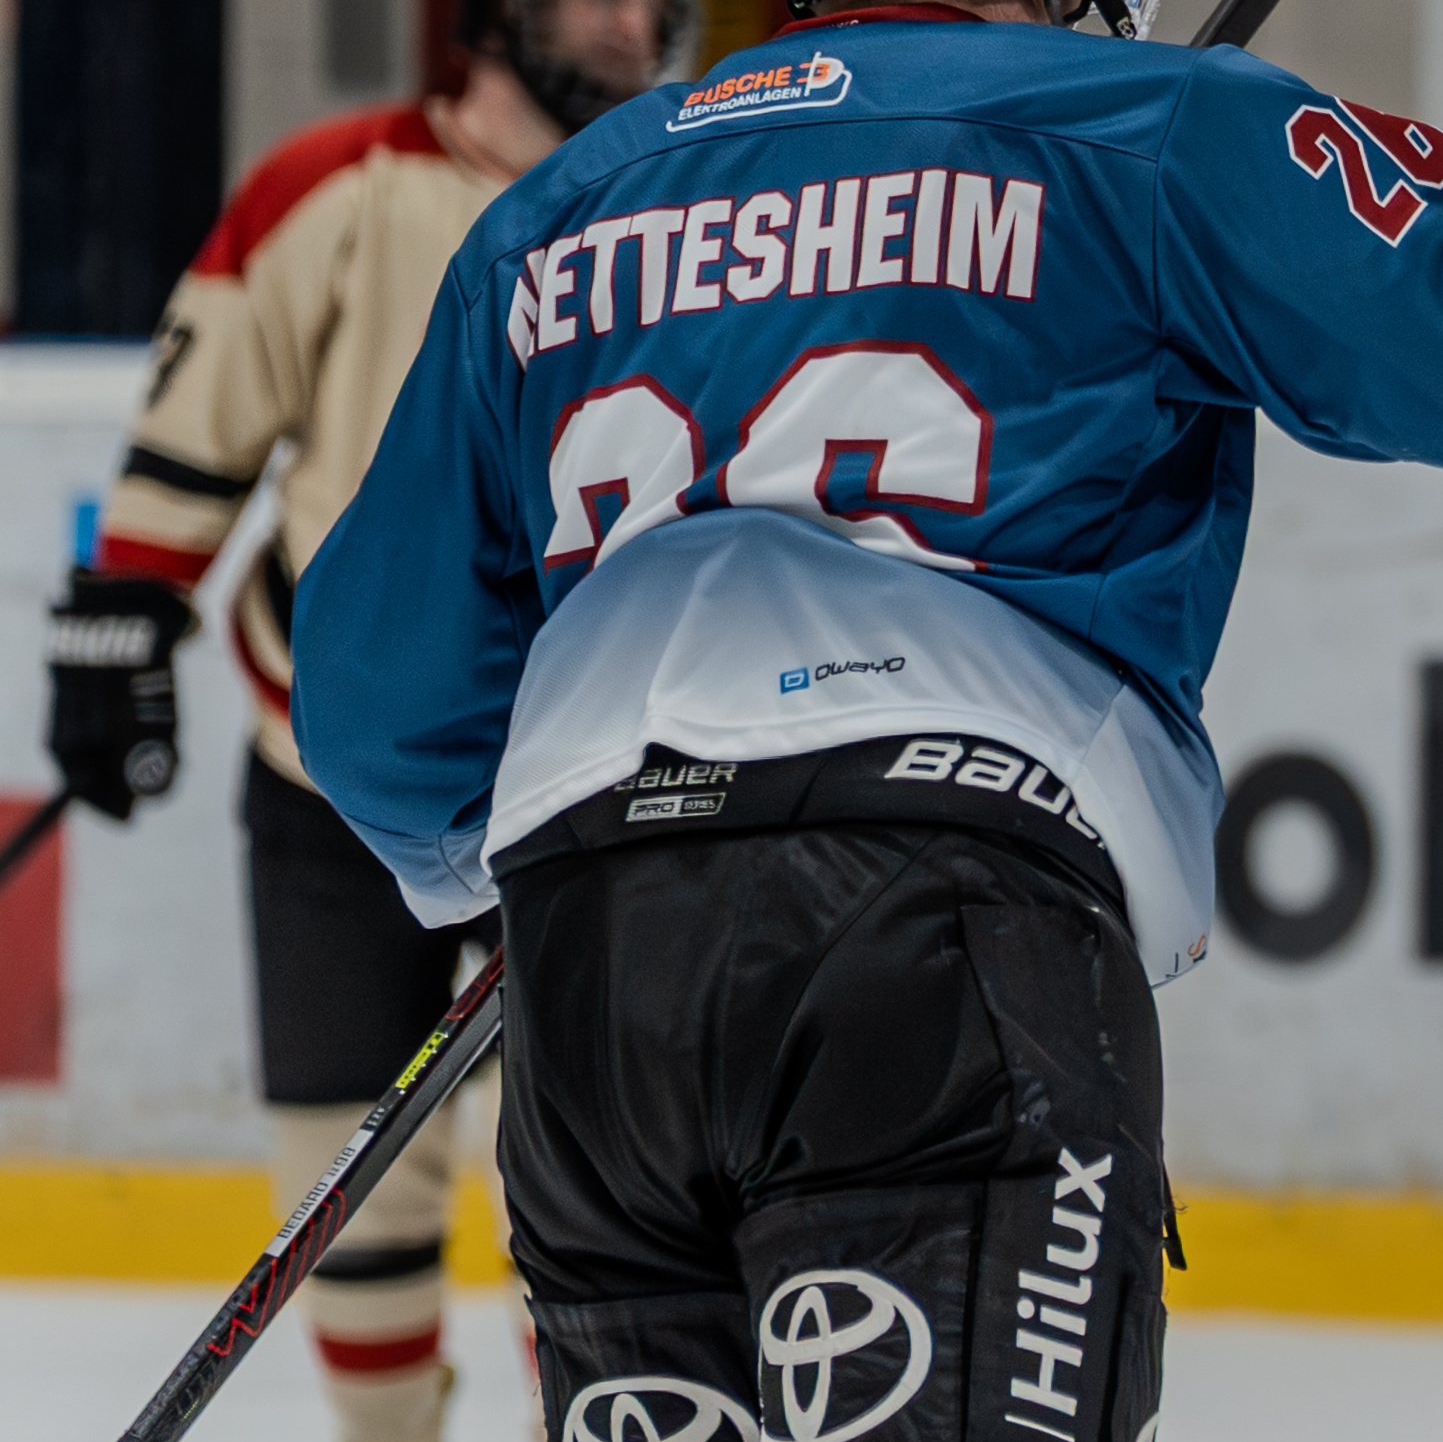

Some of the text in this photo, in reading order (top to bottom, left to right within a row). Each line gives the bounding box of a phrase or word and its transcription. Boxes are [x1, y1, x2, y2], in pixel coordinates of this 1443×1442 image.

[678, 87, 802, 121] ELEKTROANLAGEN
[684, 65, 793, 108] BUSCHE
[507, 168, 1045, 373] NETTESHEIM
[278, 1179, 330, 1243] BEDARD
[1008, 1145, 1112, 1418] Hilux
